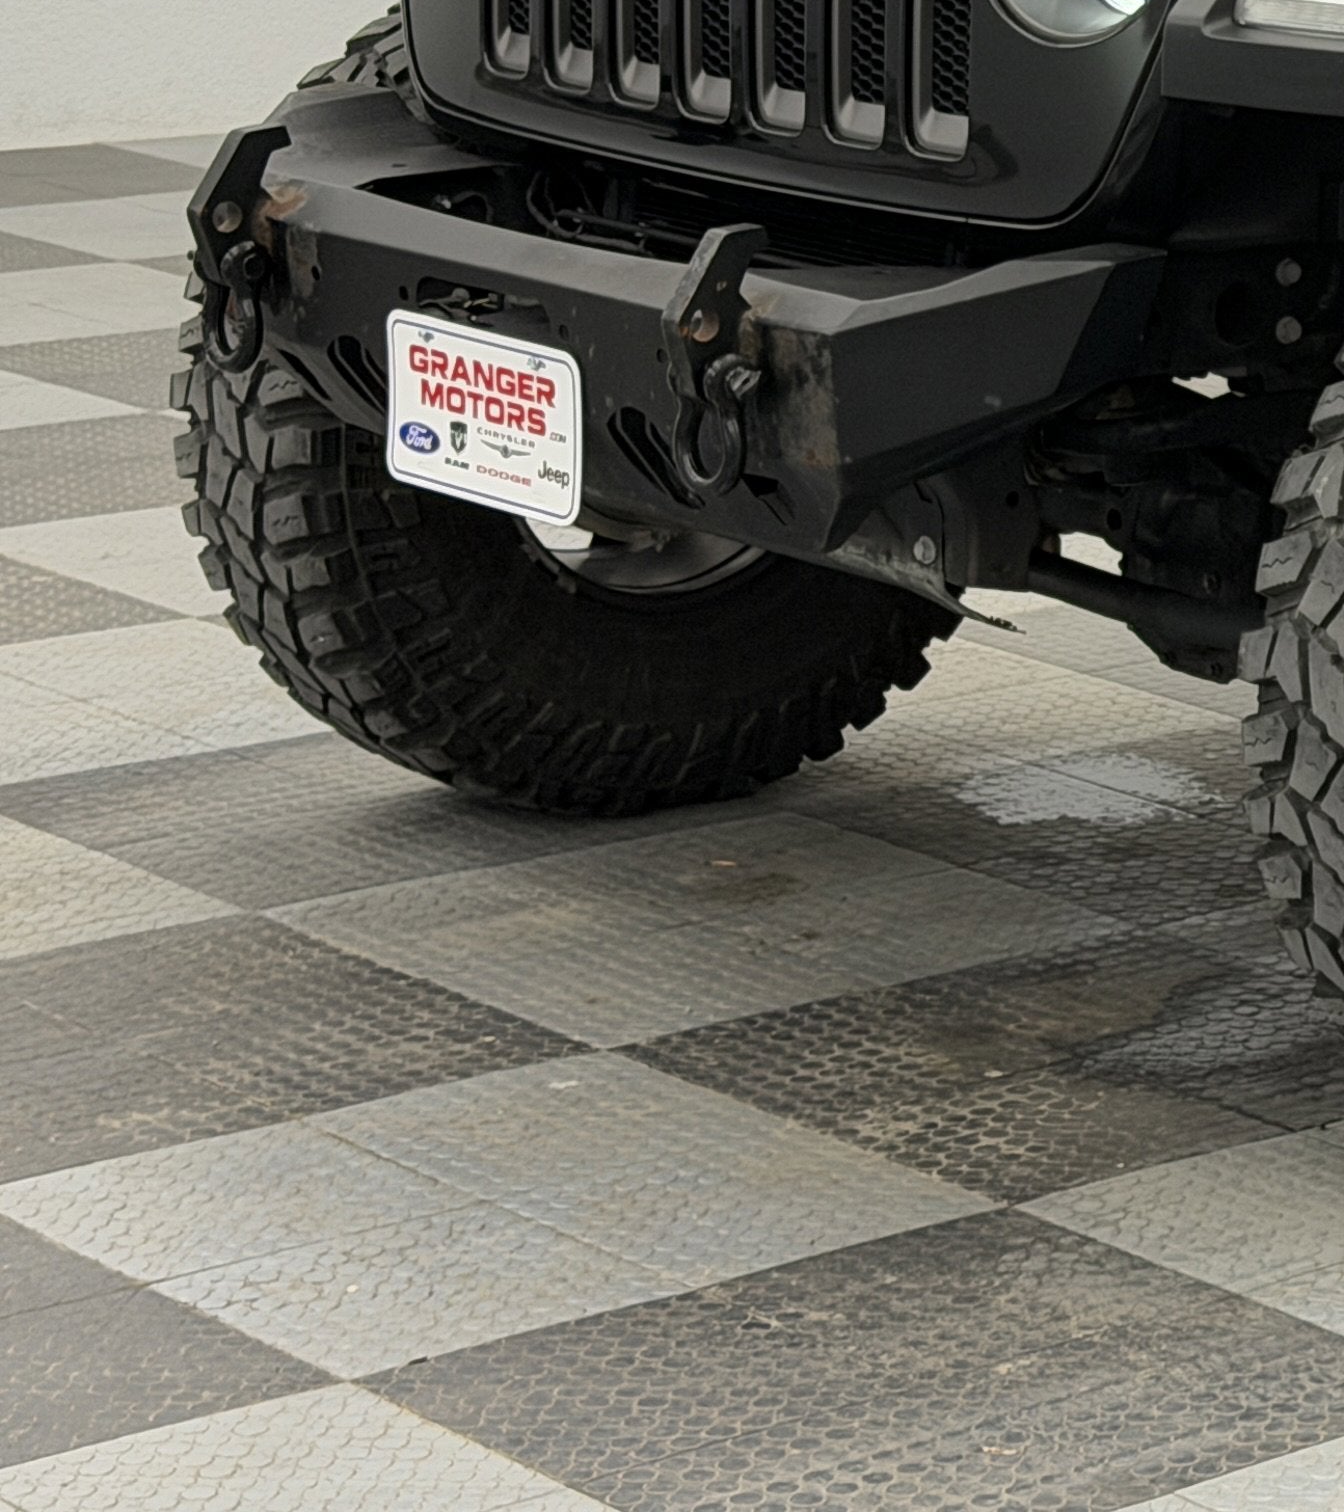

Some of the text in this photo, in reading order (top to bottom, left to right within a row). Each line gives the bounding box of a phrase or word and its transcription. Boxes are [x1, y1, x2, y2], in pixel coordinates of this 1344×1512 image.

[408, 344, 556, 408] GRANGER
[421, 378, 547, 437] MOTORS
[475, 426, 536, 449] CHRYSLER
[444, 456, 471, 471] RAM
[475, 463, 532, 487] DODGE
[538, 460, 570, 490] Jeep
